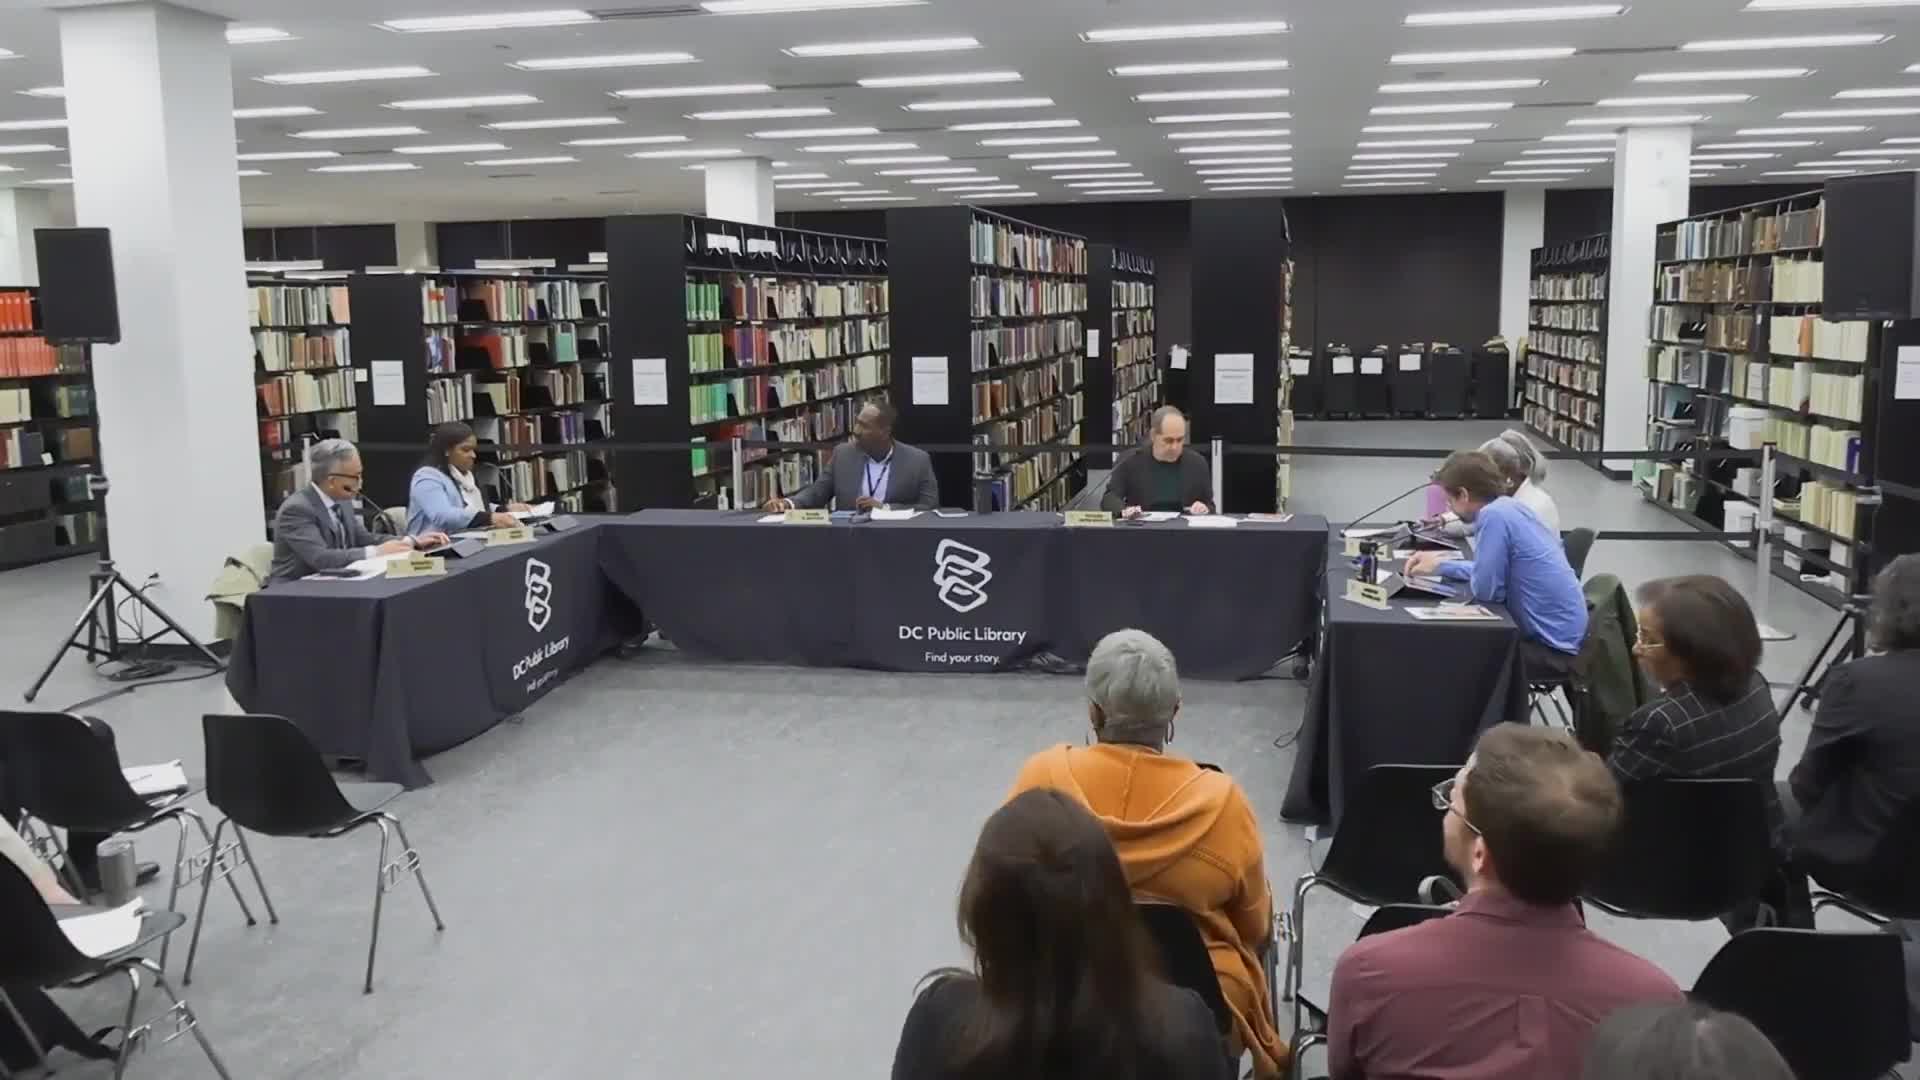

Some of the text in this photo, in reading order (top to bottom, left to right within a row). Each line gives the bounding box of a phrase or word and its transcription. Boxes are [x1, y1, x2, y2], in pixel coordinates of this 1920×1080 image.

[899, 625, 1027, 645] DC Public Library
[925, 652, 947, 663] Find
[949, 654, 972, 665] your
[512, 659, 528, 680] DC
